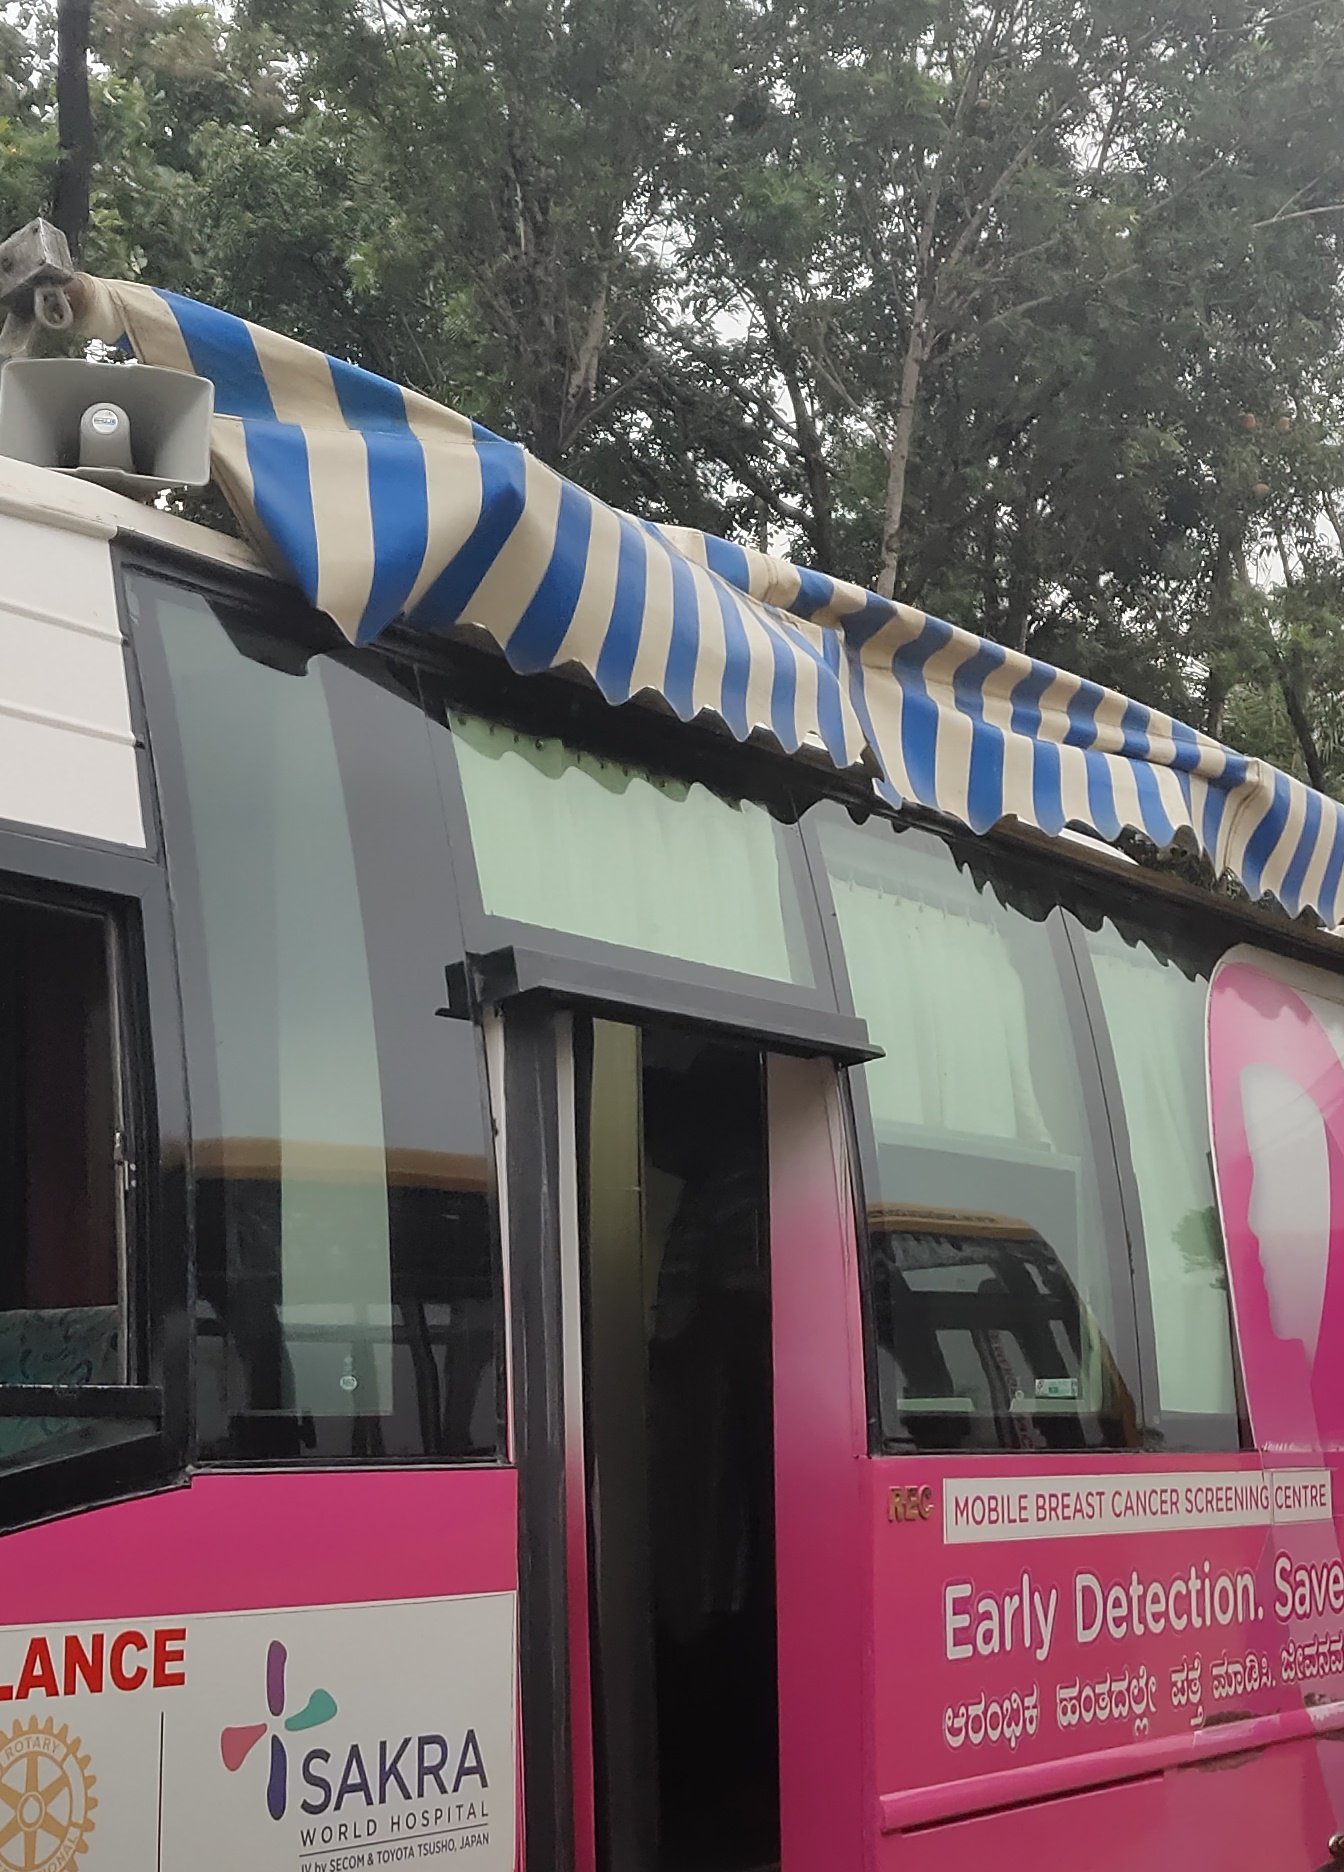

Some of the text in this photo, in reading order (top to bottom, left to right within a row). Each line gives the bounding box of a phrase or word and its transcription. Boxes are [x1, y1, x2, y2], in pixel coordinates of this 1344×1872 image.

[953, 1483, 1328, 1527] MOBILE BREAST CANCER SCREENING CENTRE
[944, 1573, 1057, 1661] Early
[1074, 1559, 1264, 1643] Detection.
[944, 1683, 1039, 1748] ಆರಂಭಿಕ
[1169, 1656, 1205, 1726] ಪತ್ತೆ
[4, 1736, 61, 1761] ROTARY
[300, 1728, 489, 1815] SAKRA
[300, 1801, 489, 1847] WORLD HOSPITAL
[329, 1854, 365, 1872] SECOM
[367, 1853, 374, 1866] &
[377, 1846, 415, 1865] TOYOTA
[417, 1838, 457, 1857] TSUSHO,
[459, 1832, 490, 1848] JAPAN
